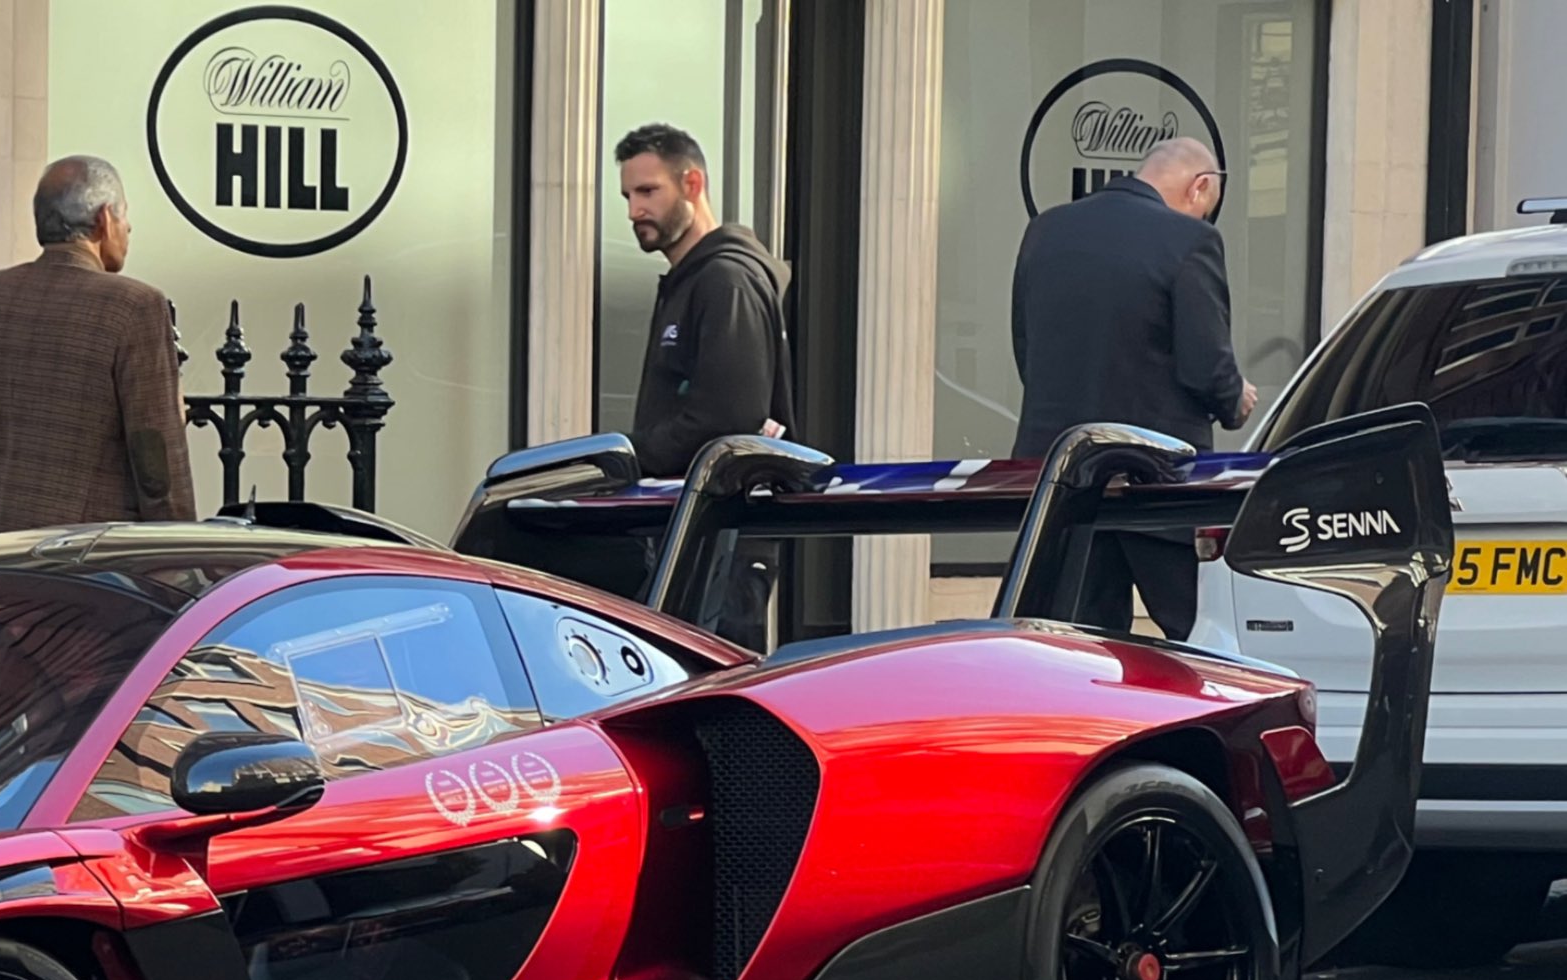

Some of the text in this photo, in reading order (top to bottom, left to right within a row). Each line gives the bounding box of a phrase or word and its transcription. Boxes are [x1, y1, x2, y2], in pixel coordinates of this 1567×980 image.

[203, 46, 351, 120] William
[215, 122, 349, 211] HILL
[1317, 510, 1401, 540] SENNA
[1446, 547, 1566, 587] 5 FMC
